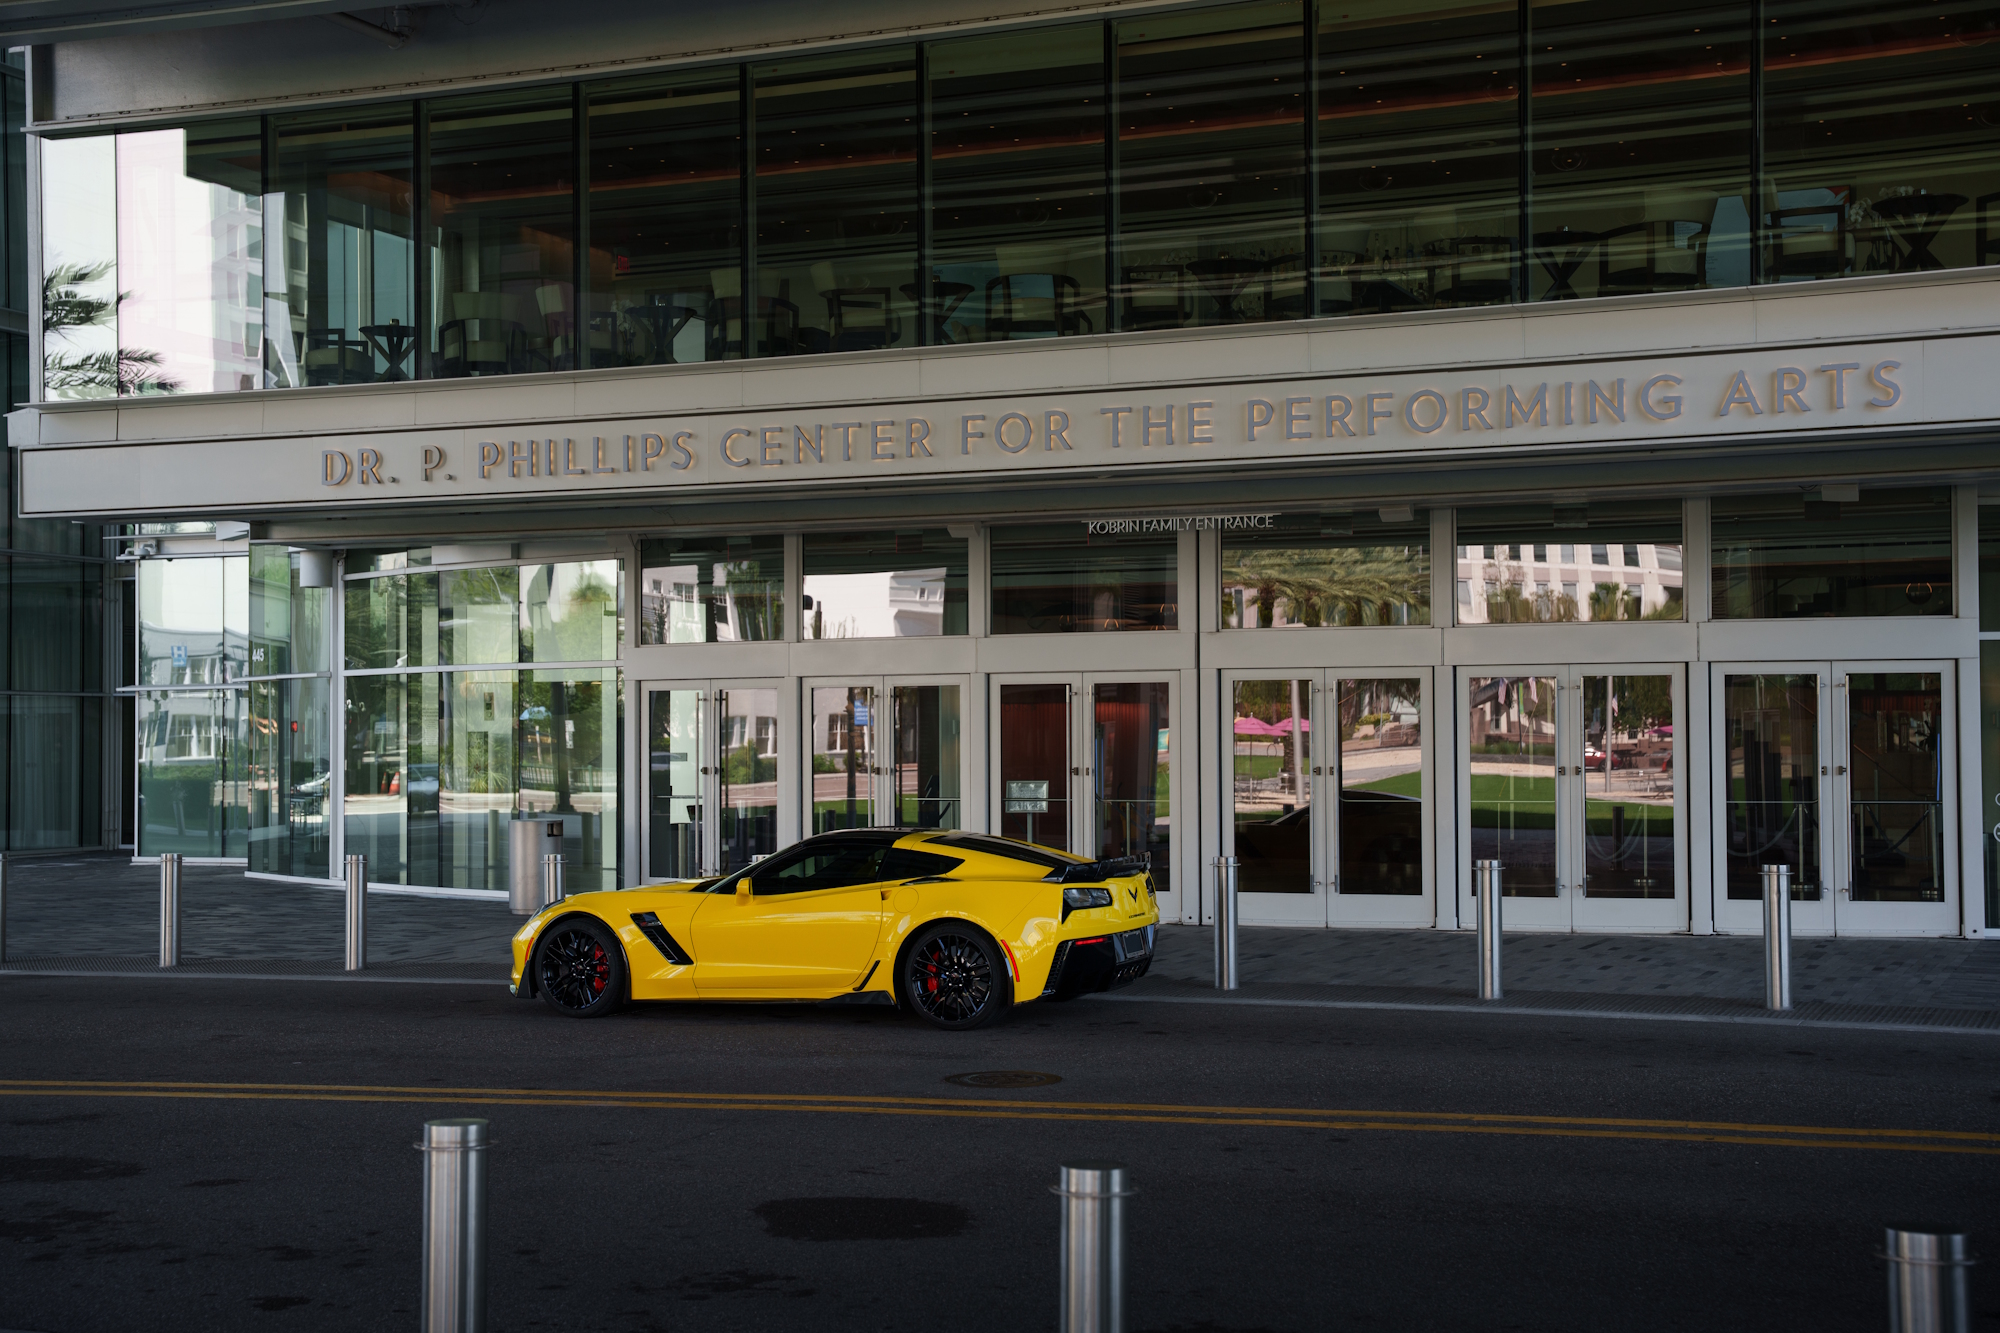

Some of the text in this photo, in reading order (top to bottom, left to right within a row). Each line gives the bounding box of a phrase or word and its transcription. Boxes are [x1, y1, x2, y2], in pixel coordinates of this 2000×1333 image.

[321, 360, 1902, 487] DR. P. PHILLIPS CENTER FOR THE PERFORMING ARTS
[1088, 515, 1274, 535] KOBRIN FAMILY ENTRANCE
[252, 648, 264, 662] 445
